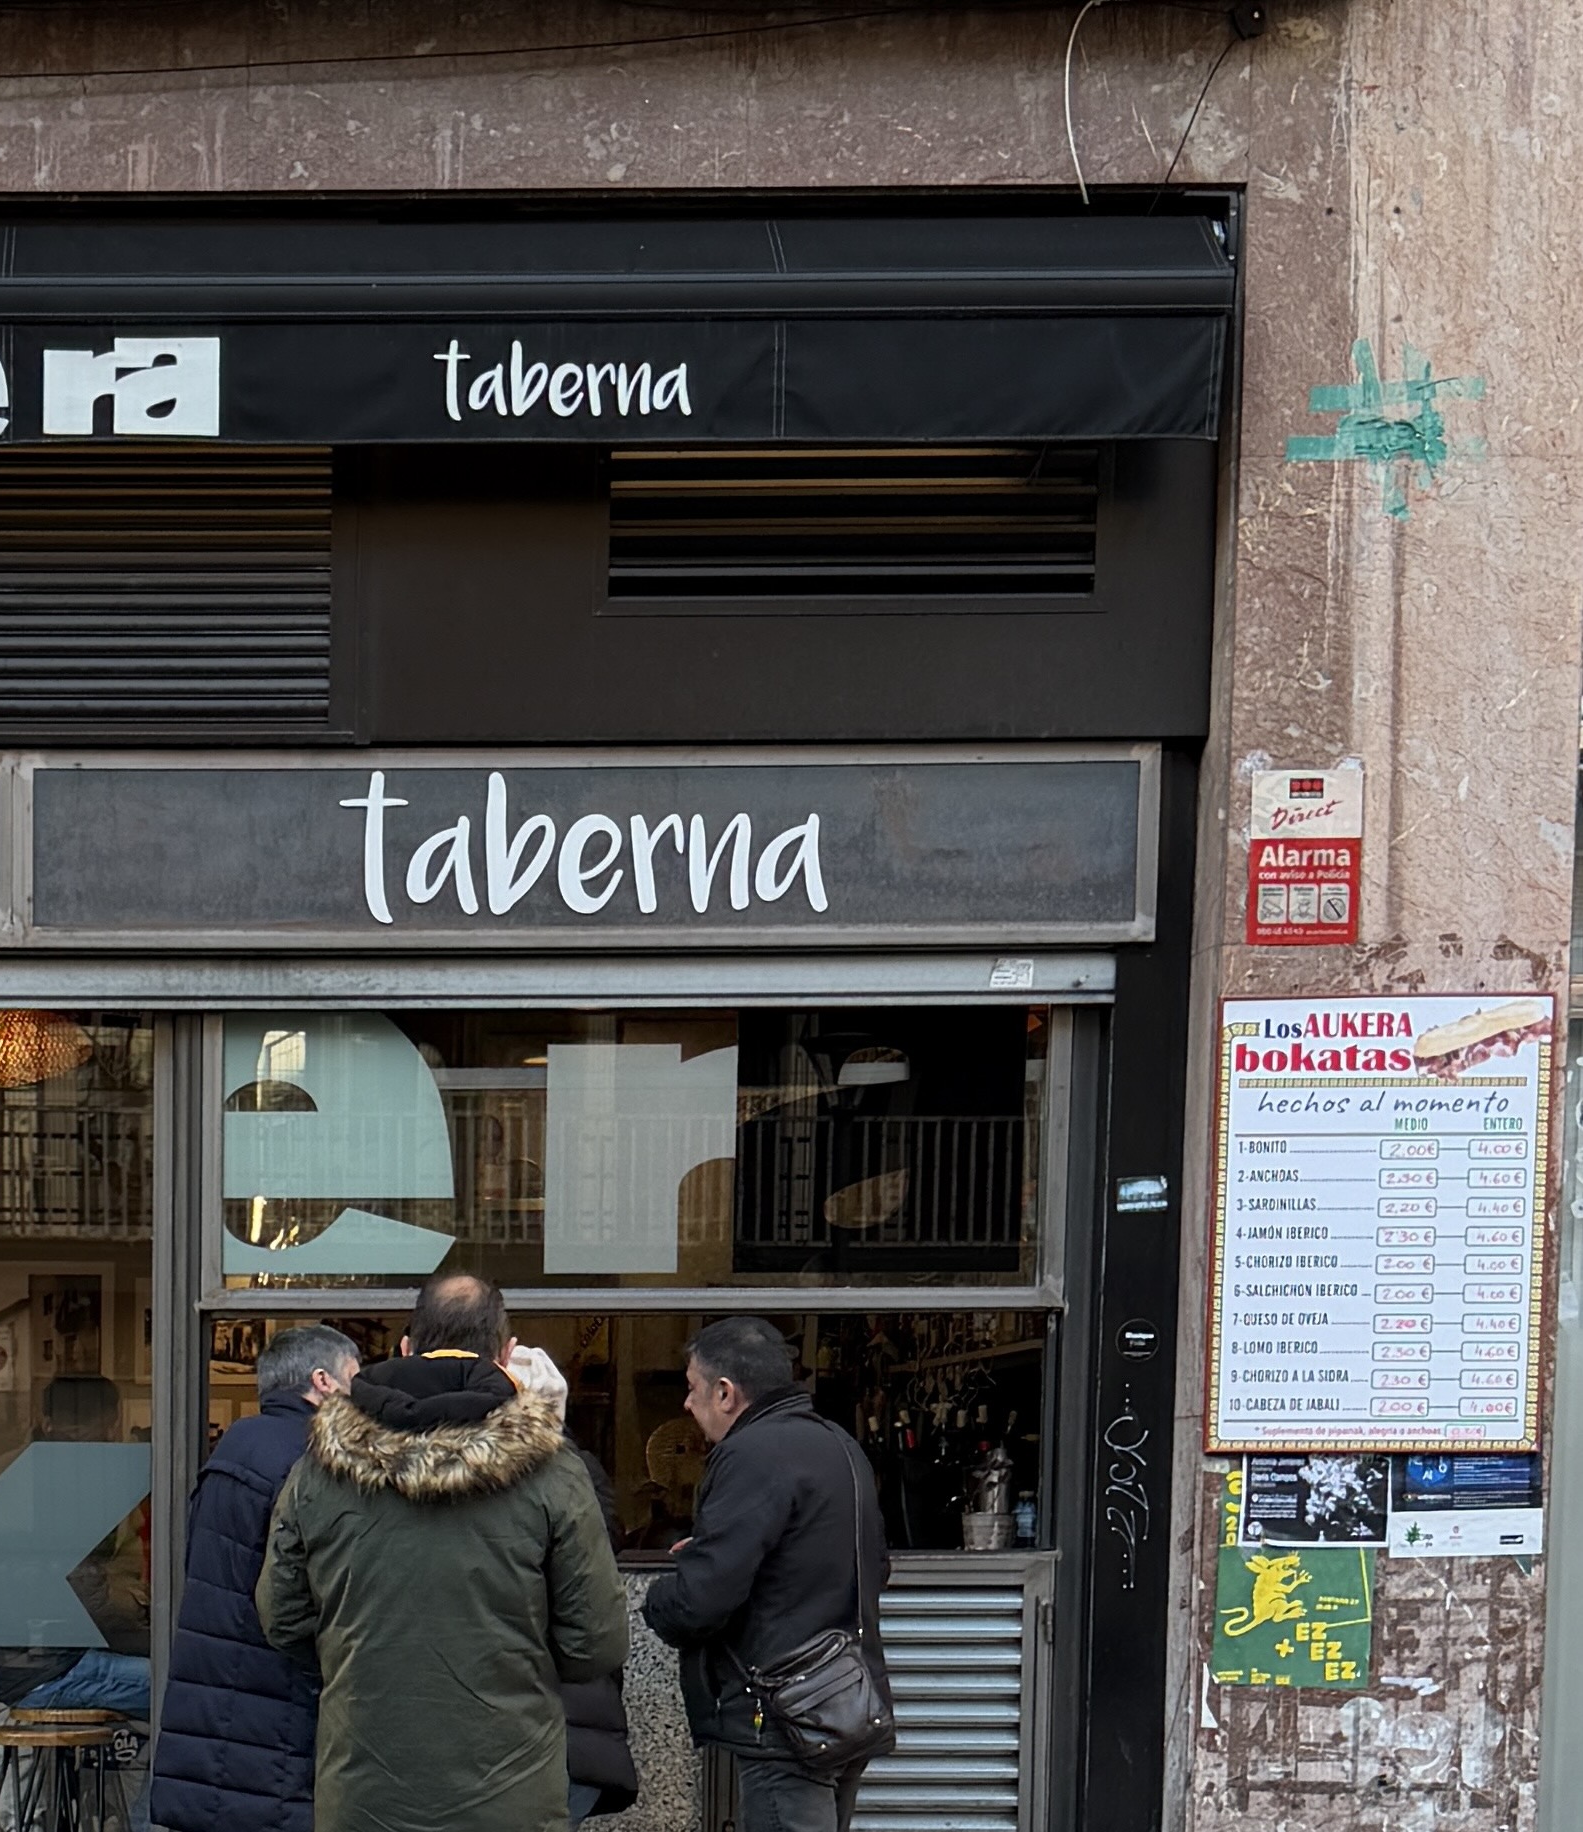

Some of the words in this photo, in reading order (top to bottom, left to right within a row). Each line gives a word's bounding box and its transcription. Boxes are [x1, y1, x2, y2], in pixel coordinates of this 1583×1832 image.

[433, 338, 692, 419] taberna
[339, 770, 828, 924] taberna
[1258, 844, 1351, 868] Alarma
[1234, 1043, 1412, 1073] bokatas
[1258, 1091, 1350, 1113] hechos
[1359, 1091, 1382, 1112] al
[1393, 1090, 1510, 1113] momento
[1394, 1117, 1428, 1131] MEDIO
[1483, 1117, 1523, 1131] ENTERO
[1286, 1226, 1328, 1239] IBERICO
[1296, 1255, 1338, 1268] IBERICO
[1316, 1283, 1358, 1297] IBERICO
[1281, 1312, 1294, 1325] DE
[1298, 1312, 1329, 1325] OVEJA
[1277, 1341, 1318, 1354] IBERICO
[1292, 1369, 1299, 1382] A
[1302, 1369, 1315, 1382] LA
[1318, 1369, 1349, 1383] SIDRA
[1290, 1398, 1302, 1411] DE
[1296, 1621, 1327, 1642] EZ
[1311, 1641, 1342, 1661] EZ
[1325, 1661, 1357, 1681] EZ
